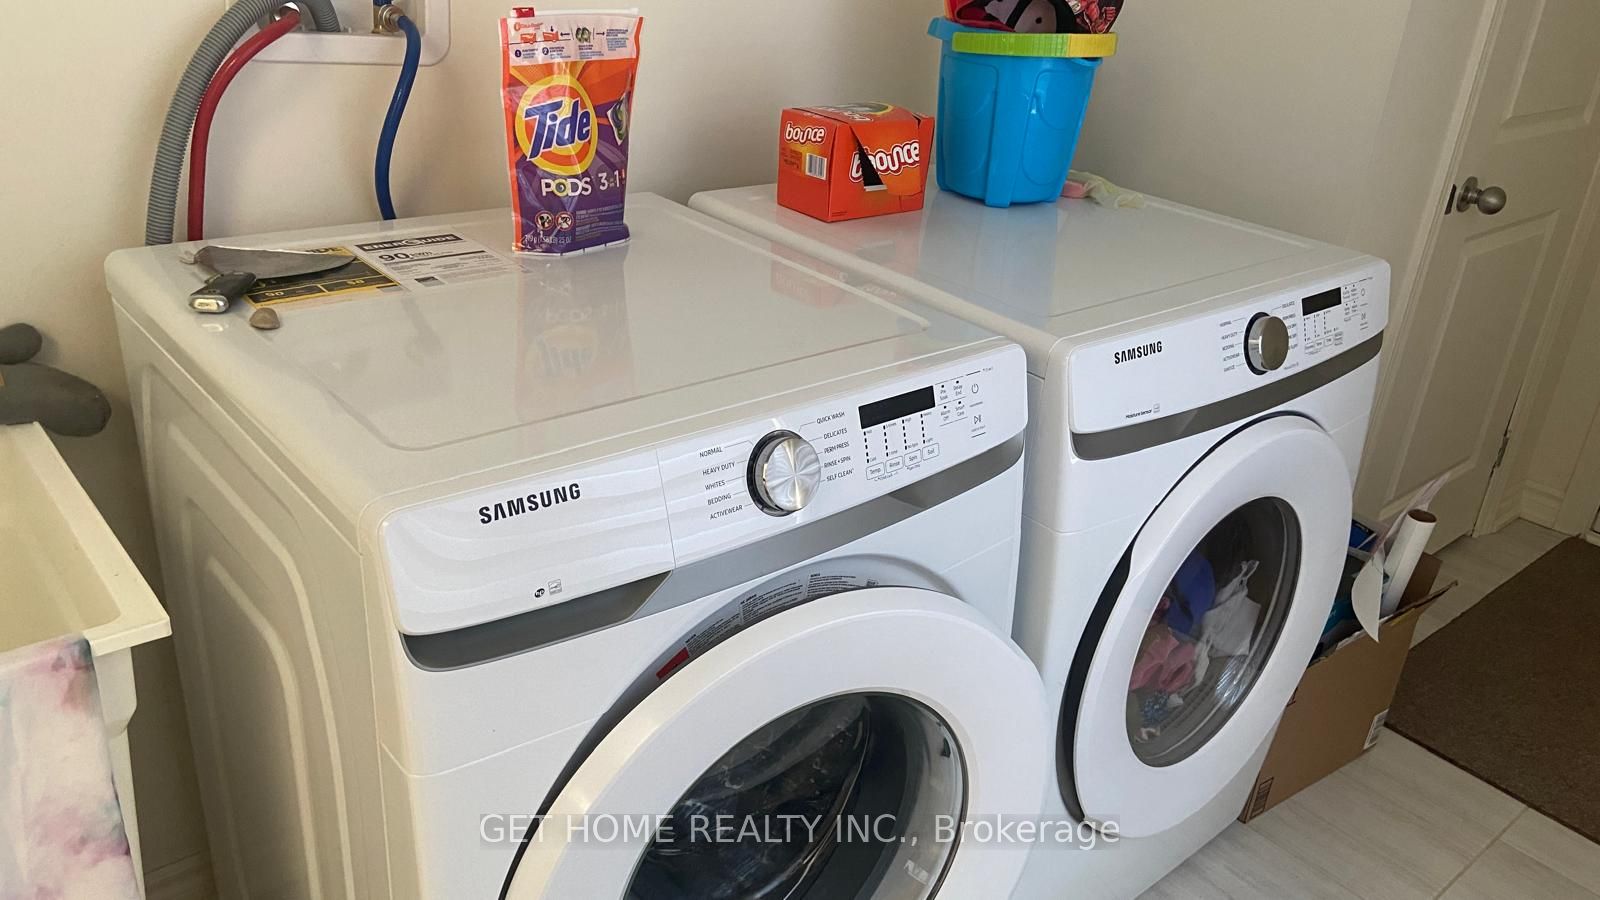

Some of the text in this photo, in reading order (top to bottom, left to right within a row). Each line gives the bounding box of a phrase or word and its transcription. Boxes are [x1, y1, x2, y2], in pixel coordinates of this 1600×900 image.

[524, 97, 592, 161] Tide
[785, 122, 826, 144] bounce
[541, 177, 592, 196] PODS
[379, 253, 410, 261] 90
[1114, 341, 1163, 365] SAMSUNG
[823, 427, 848, 440] DELICATES
[699, 446, 723, 458] NORMAL
[702, 461, 736, 476] HEAVY DUTY
[704, 480, 726, 491] WHITES
[479, 483, 581, 524] SAMSUNG
[707, 493, 732, 505] BEDDING
[710, 504, 743, 520] ACTIVEWEAR
